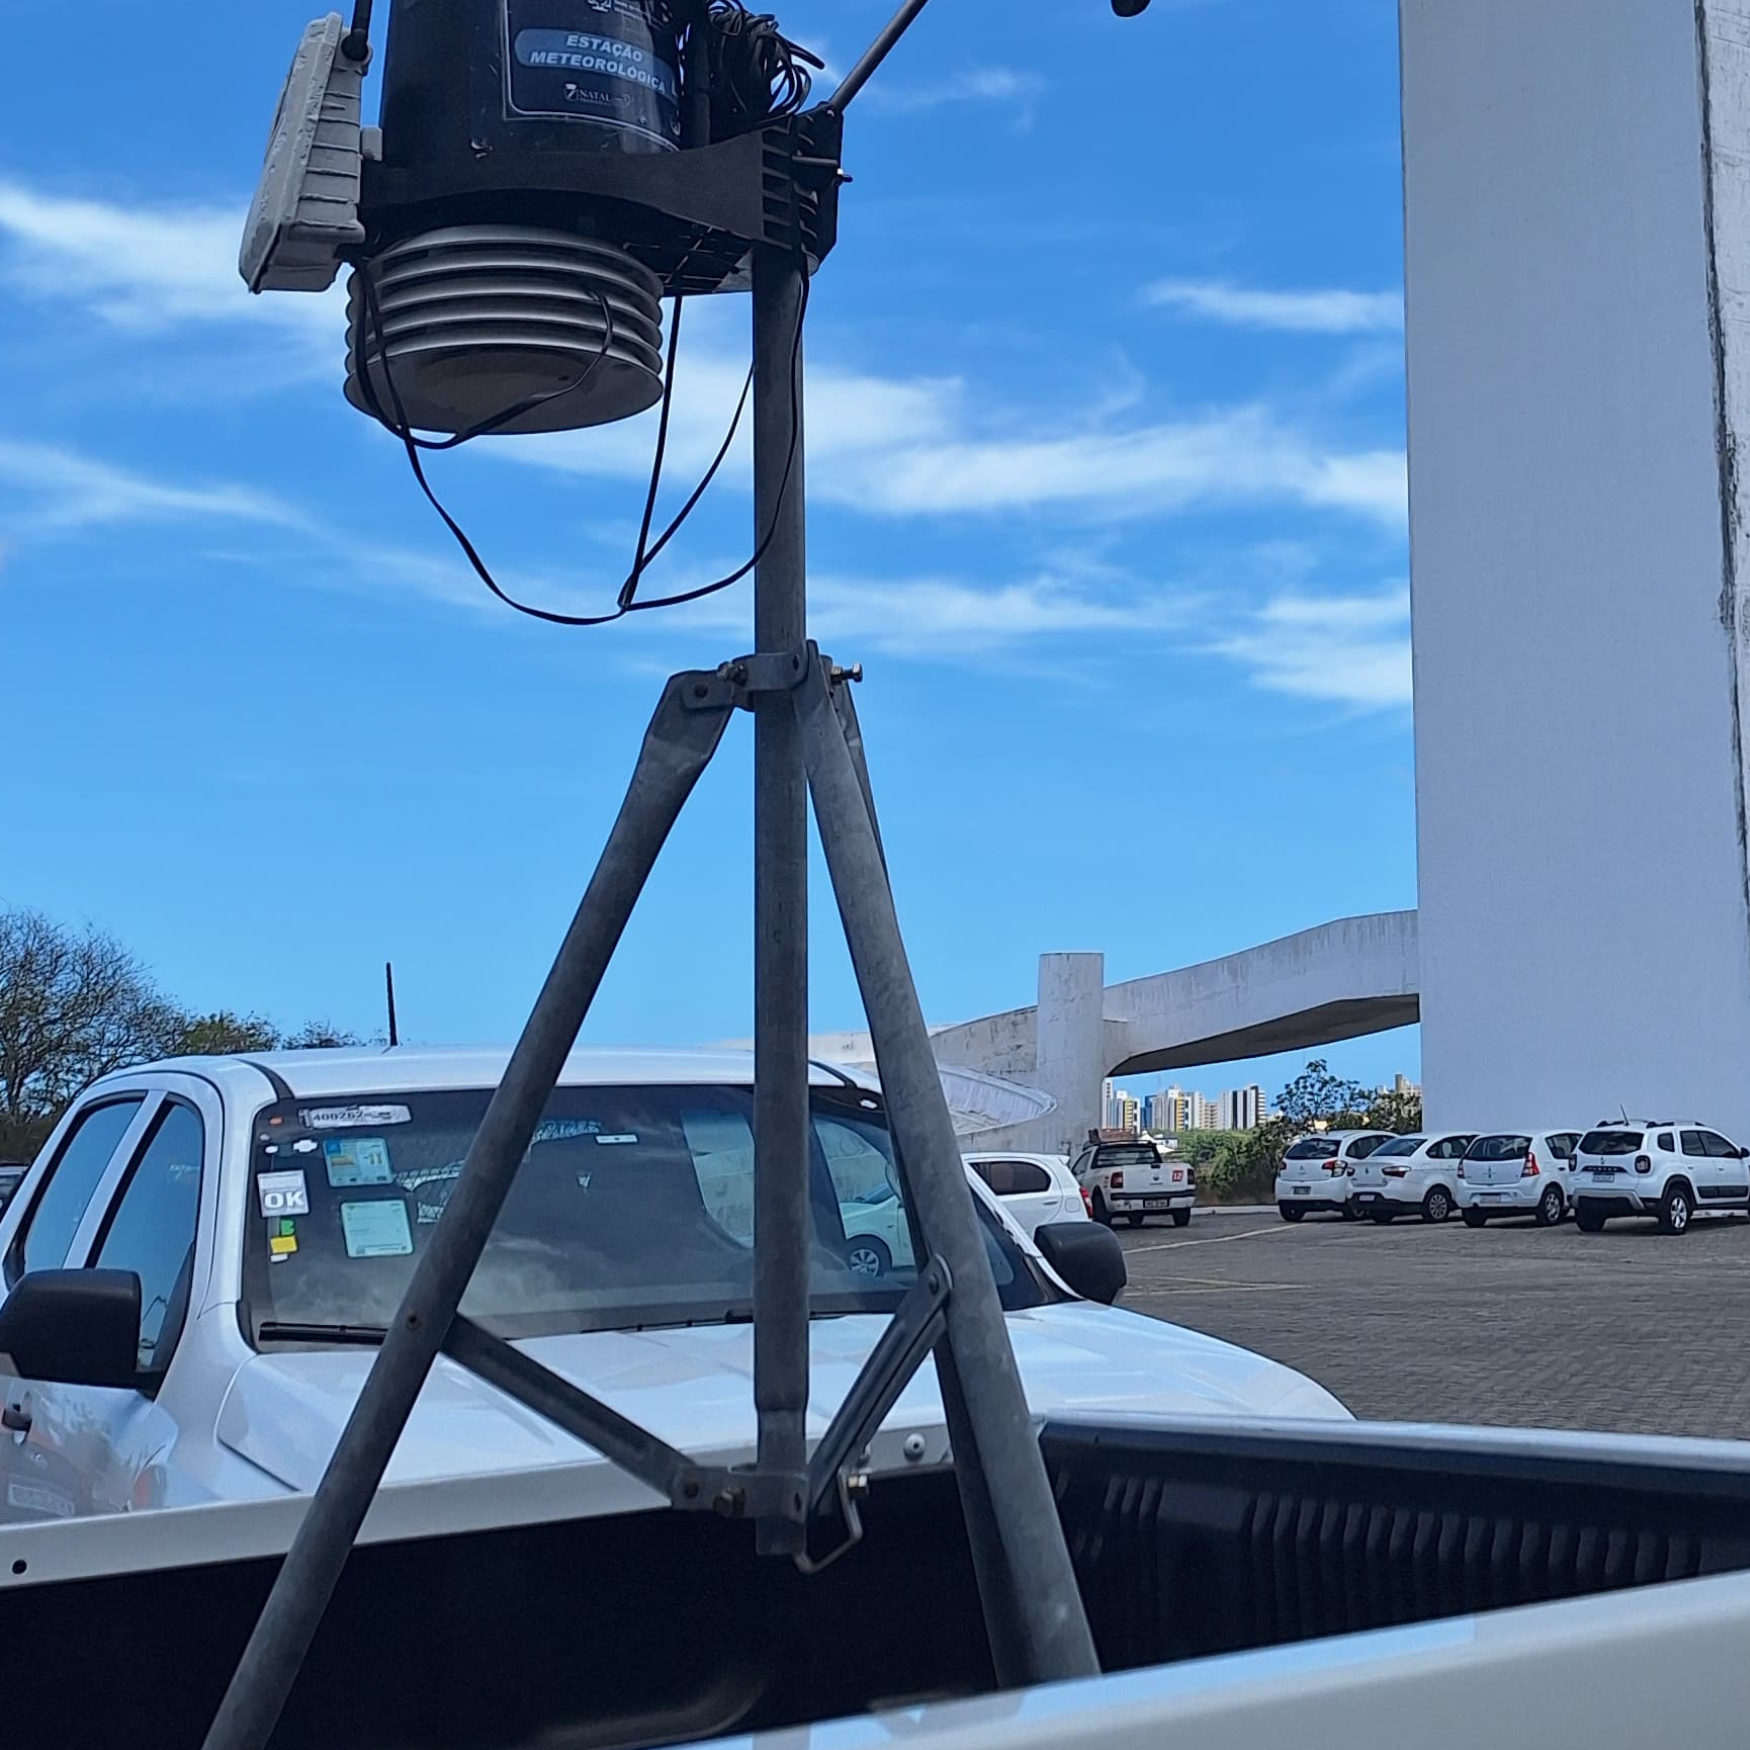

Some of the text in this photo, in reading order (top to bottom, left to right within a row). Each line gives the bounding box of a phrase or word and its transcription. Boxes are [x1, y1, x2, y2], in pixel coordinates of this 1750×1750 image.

[566, 34, 643, 63] ESTAÇÃO
[530, 51, 665, 94] METEOROLÓGICA
[264, 1191, 304, 1209] OK
